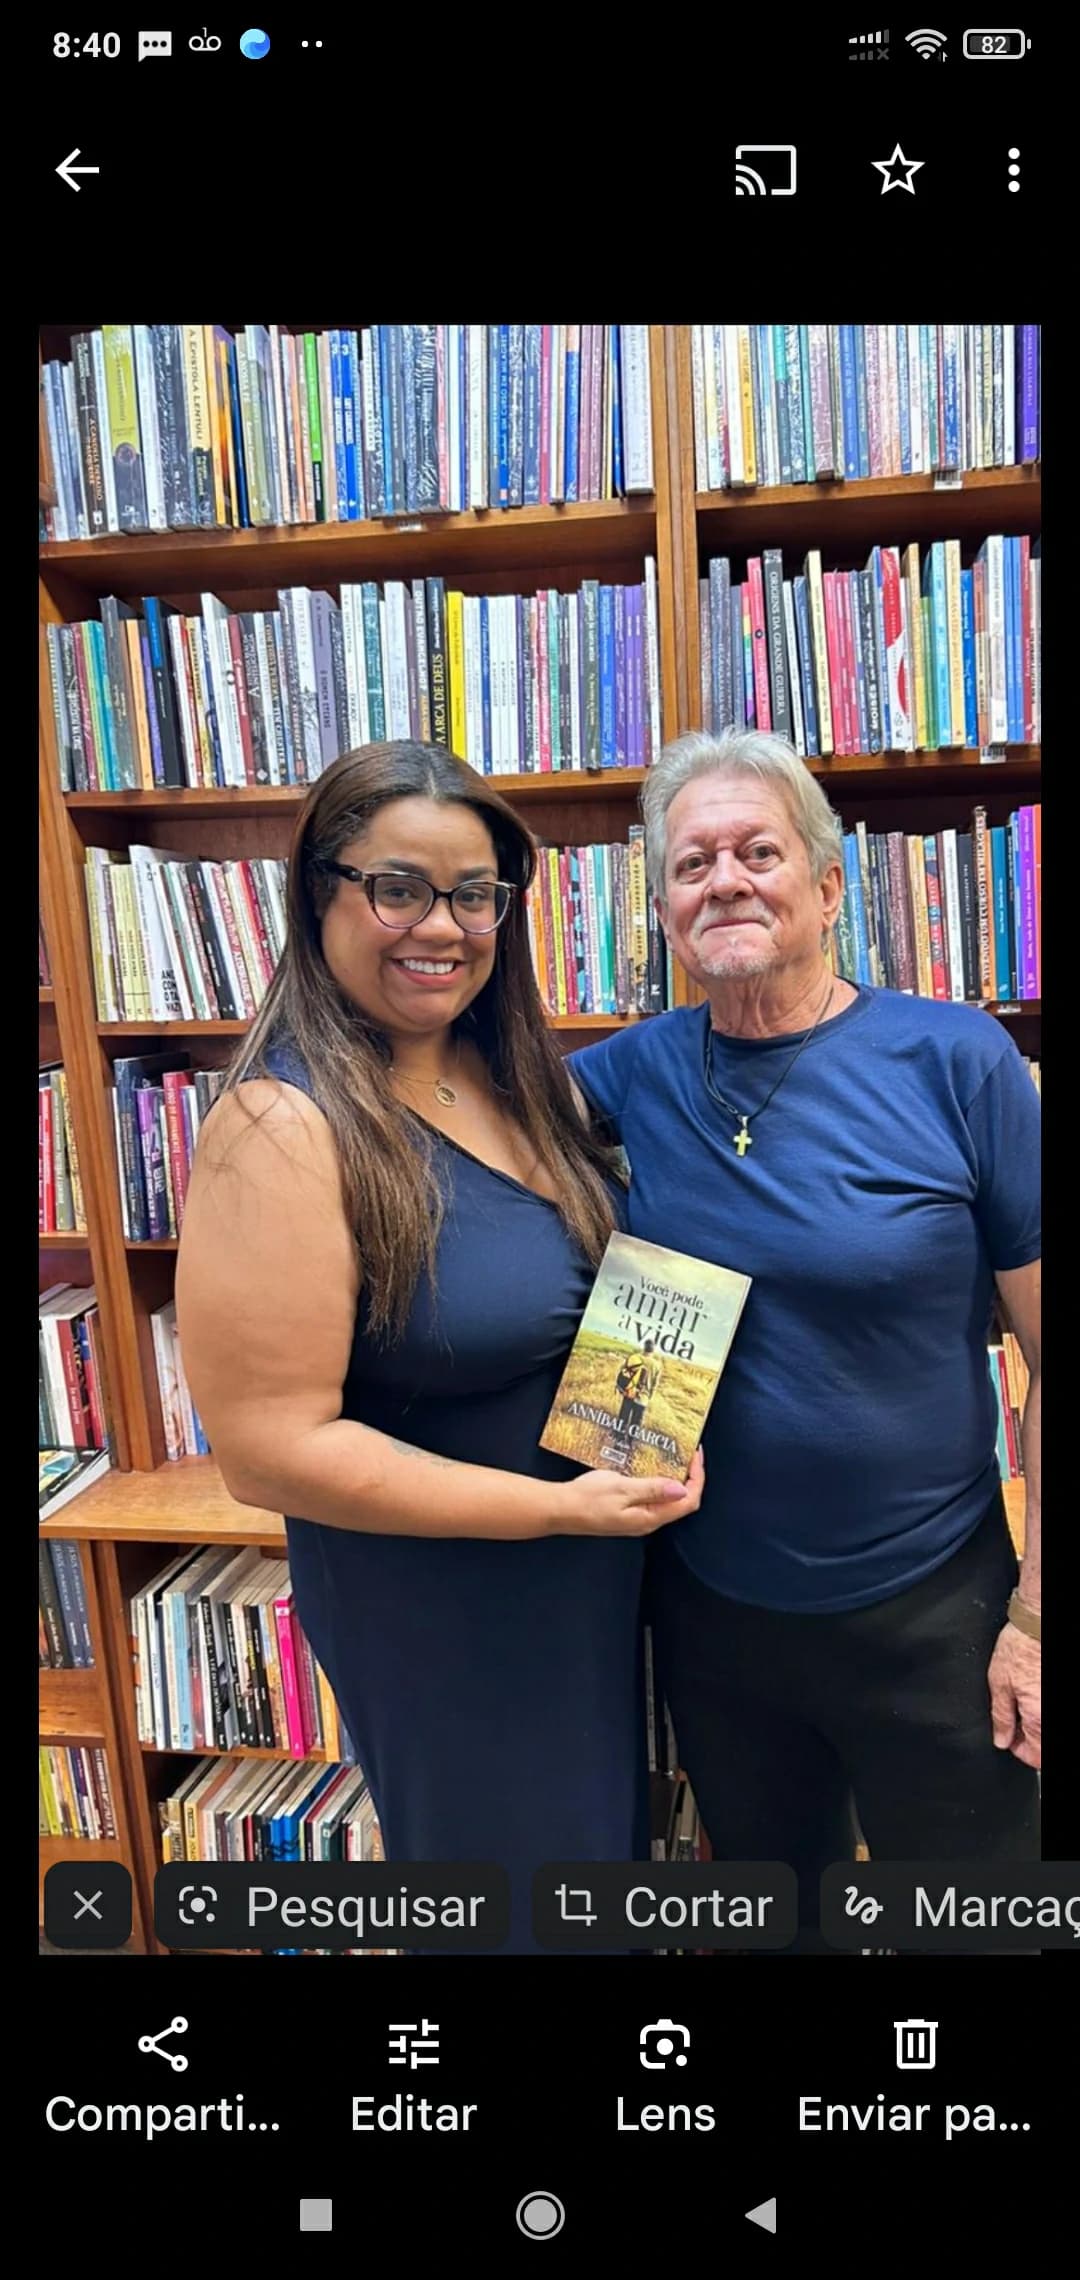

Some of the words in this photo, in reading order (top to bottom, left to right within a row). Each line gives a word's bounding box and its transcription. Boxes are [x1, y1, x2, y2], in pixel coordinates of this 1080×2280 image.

[769, 571, 781, 614] ORIGENS
[771, 615, 781, 631] DA
[432, 653, 444, 684] DEUS
[772, 632, 784, 673] GRANDE
[433, 685, 445, 701] DE
[774, 675, 786, 716] GUERRA
[434, 704, 446, 735] ARCA
[436, 736, 447, 745] A
[614, 1282, 709, 1334] amar
[639, 1275, 670, 1298] Você
[671, 1289, 704, 1310] pode
[617, 1313, 632, 1331] a
[633, 1321, 695, 1361] vida
[628, 1423, 677, 1453] GARCIA
